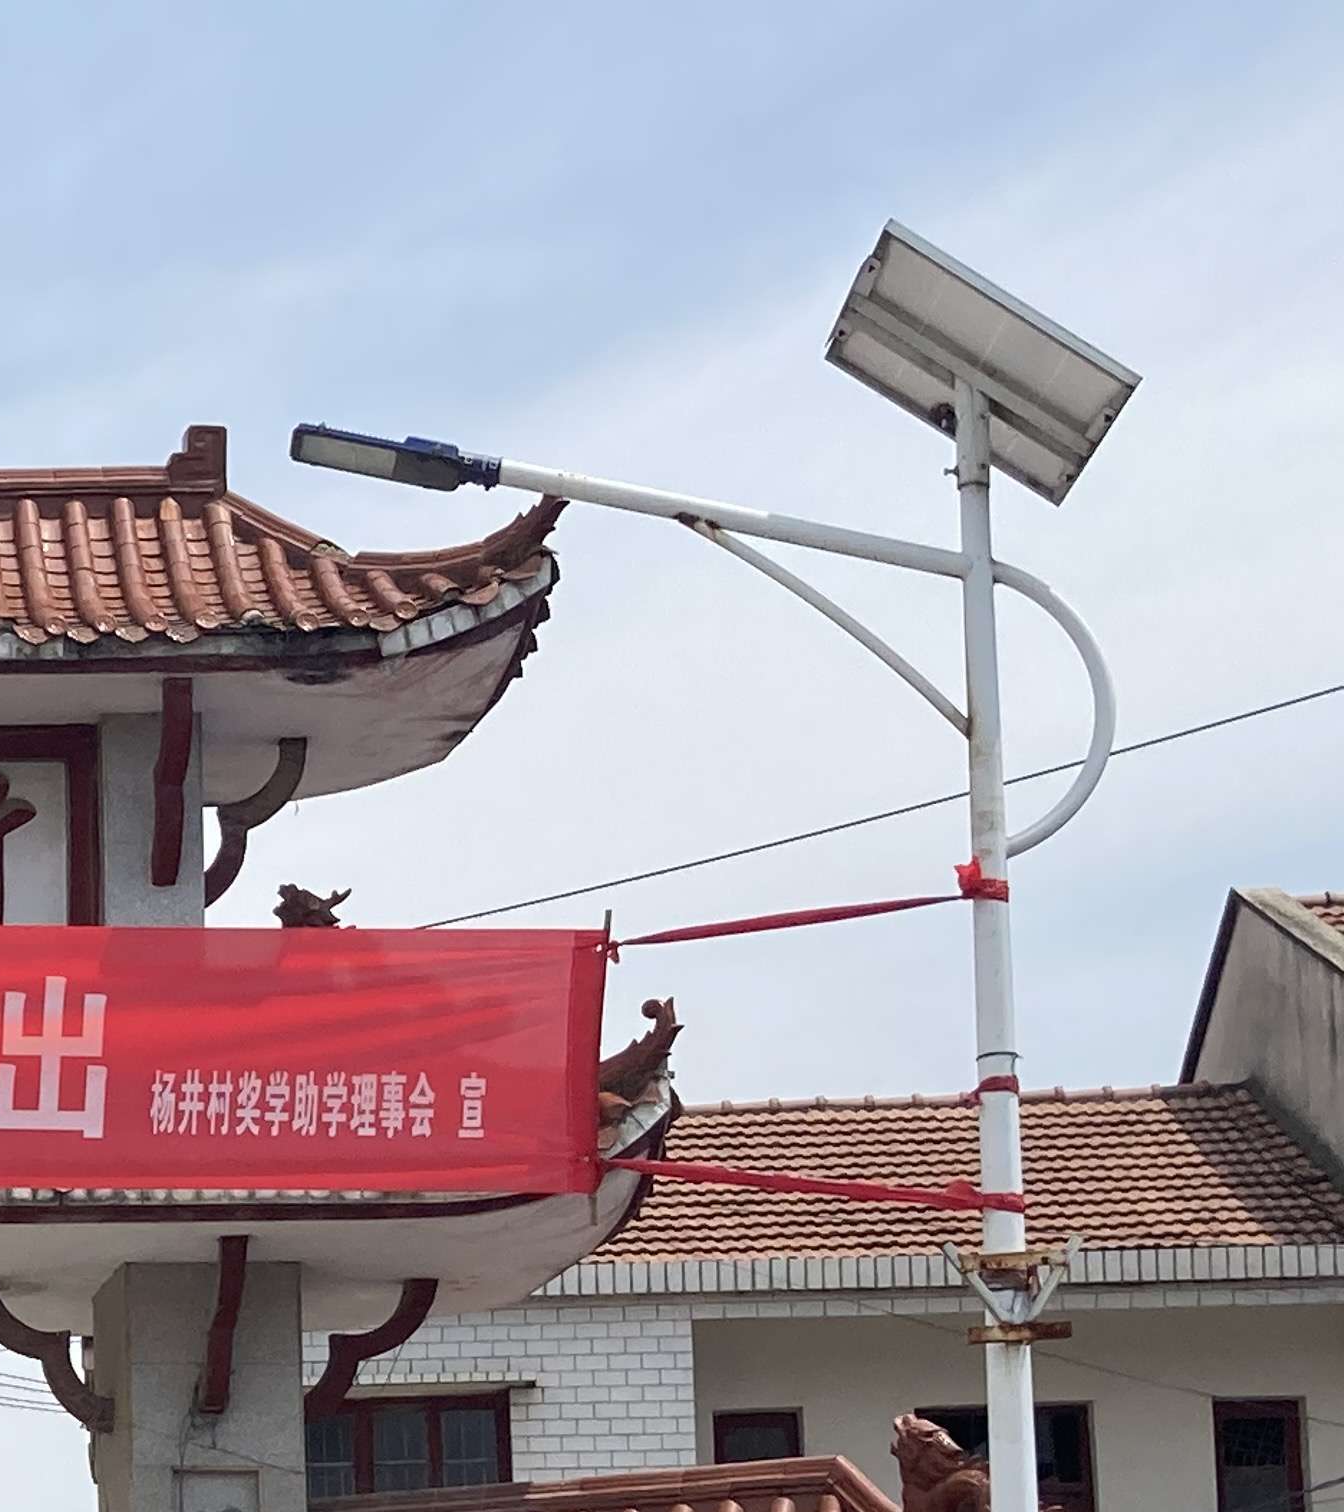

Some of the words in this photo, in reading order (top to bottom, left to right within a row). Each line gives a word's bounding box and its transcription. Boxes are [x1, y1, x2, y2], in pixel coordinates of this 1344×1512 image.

[150, 1069, 436, 1138] 杨井村奖学助学理事会
[457, 1072, 487, 1138] 宣
